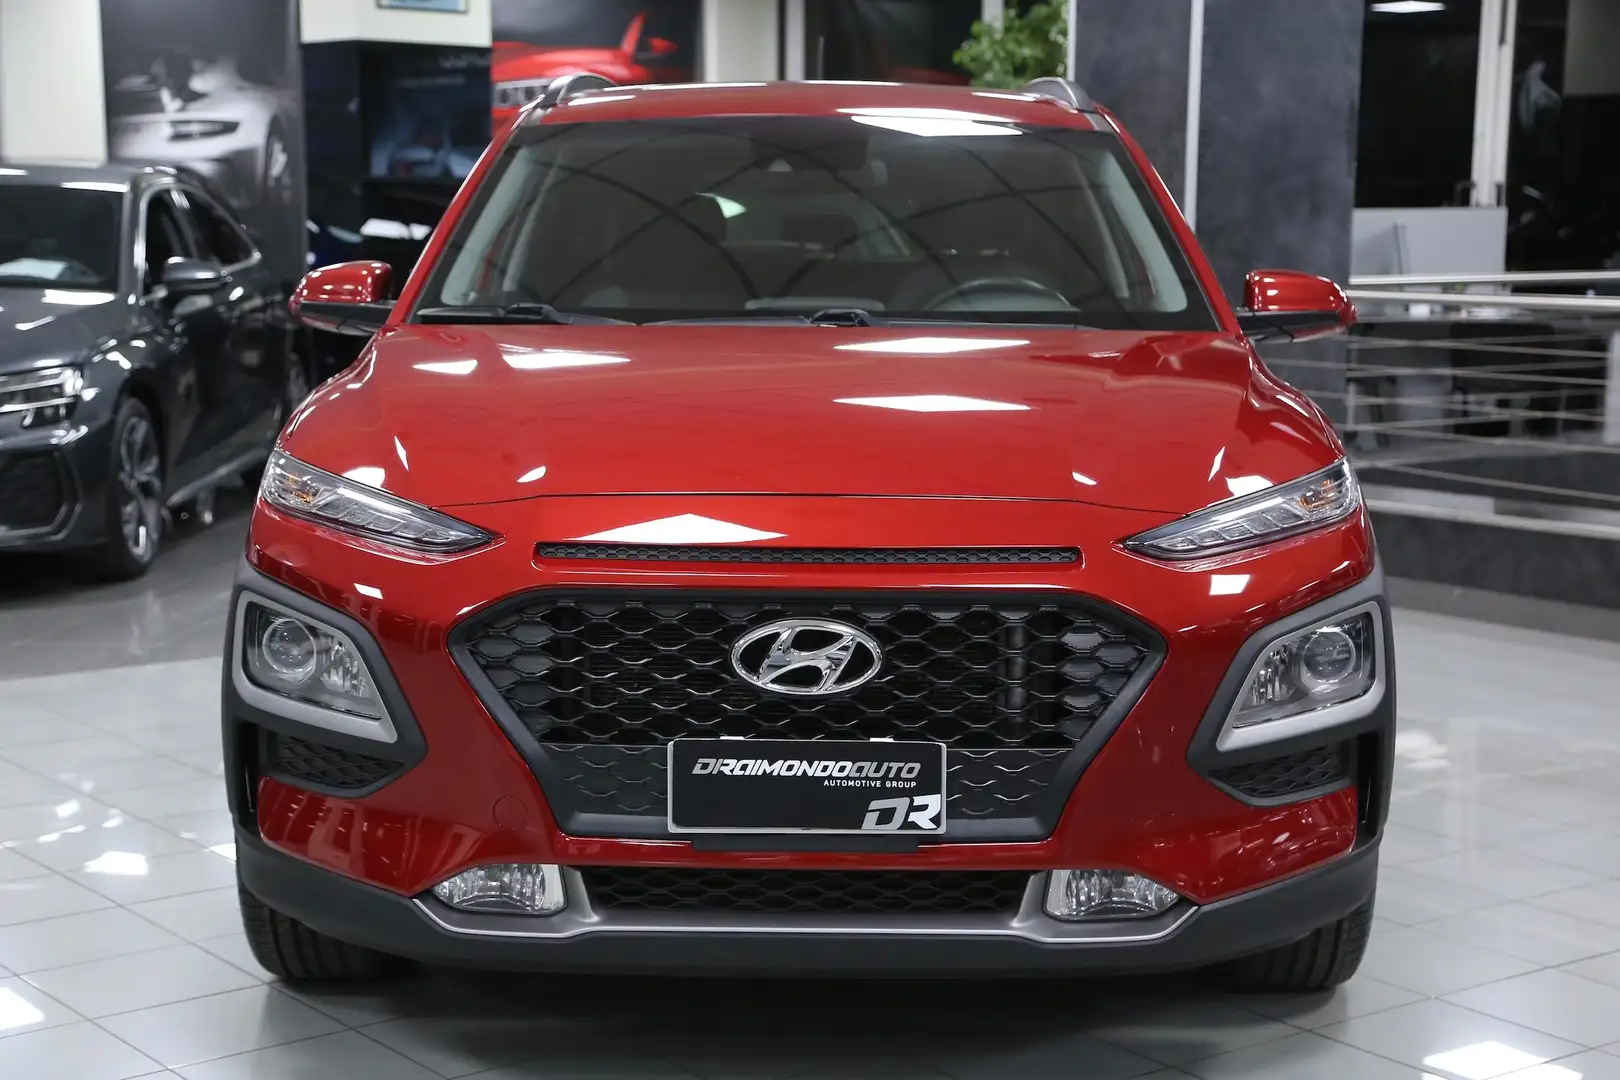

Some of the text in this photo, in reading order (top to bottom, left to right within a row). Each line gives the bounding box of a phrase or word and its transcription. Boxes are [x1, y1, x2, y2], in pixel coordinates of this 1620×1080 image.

[823, 779, 917, 788] AUTOMOTIVE GROUP
[861, 793, 942, 830] DR
